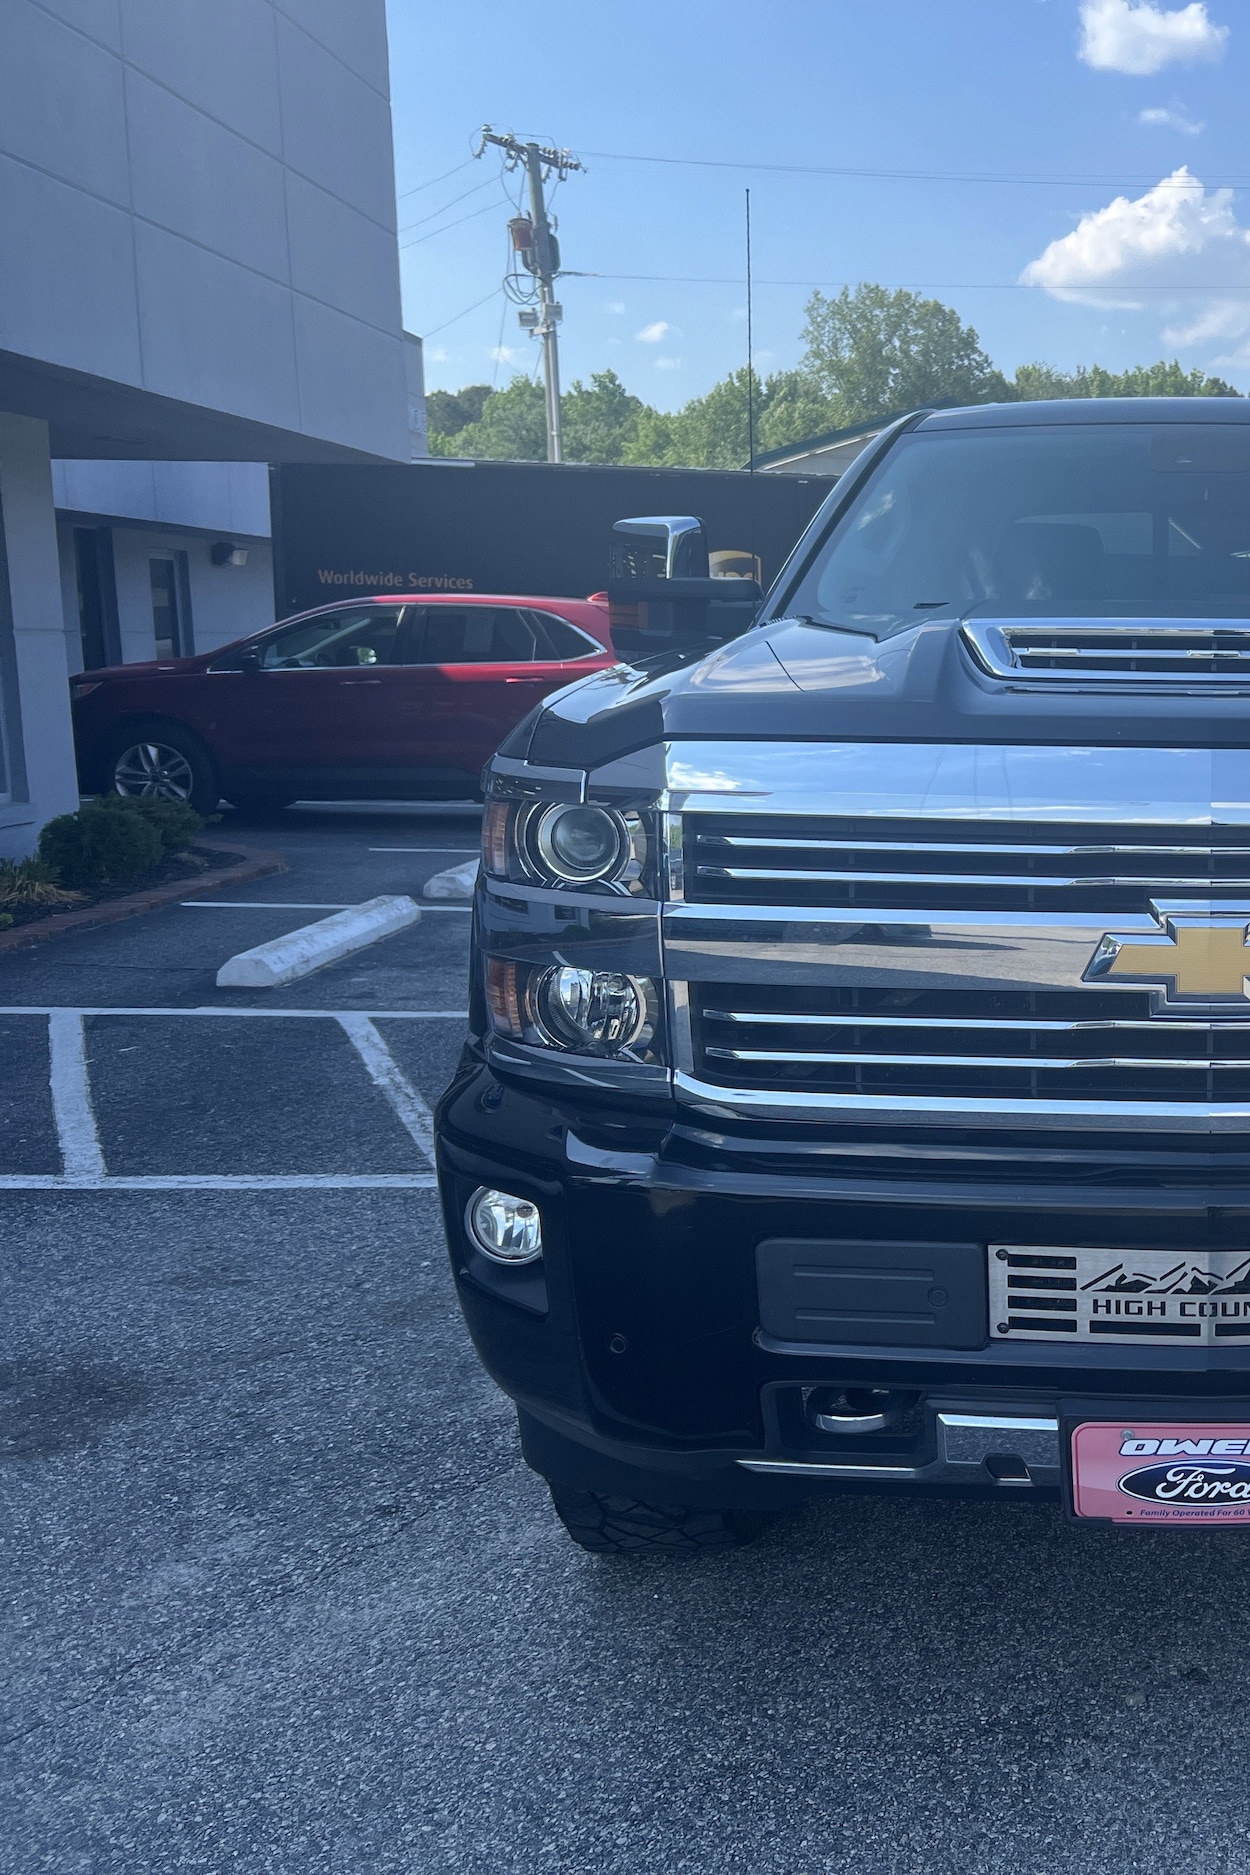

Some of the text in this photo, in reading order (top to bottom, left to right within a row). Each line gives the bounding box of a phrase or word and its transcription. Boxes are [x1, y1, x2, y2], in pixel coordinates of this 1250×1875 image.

[318, 569, 473, 590] Worldwide Services
[1092, 1298, 1166, 1317] HIGH
[1140, 1509, 1171, 1518] Family
[1172, 1509, 1215, 1518] Operated
[1233, 1509, 1245, 1517] 60
